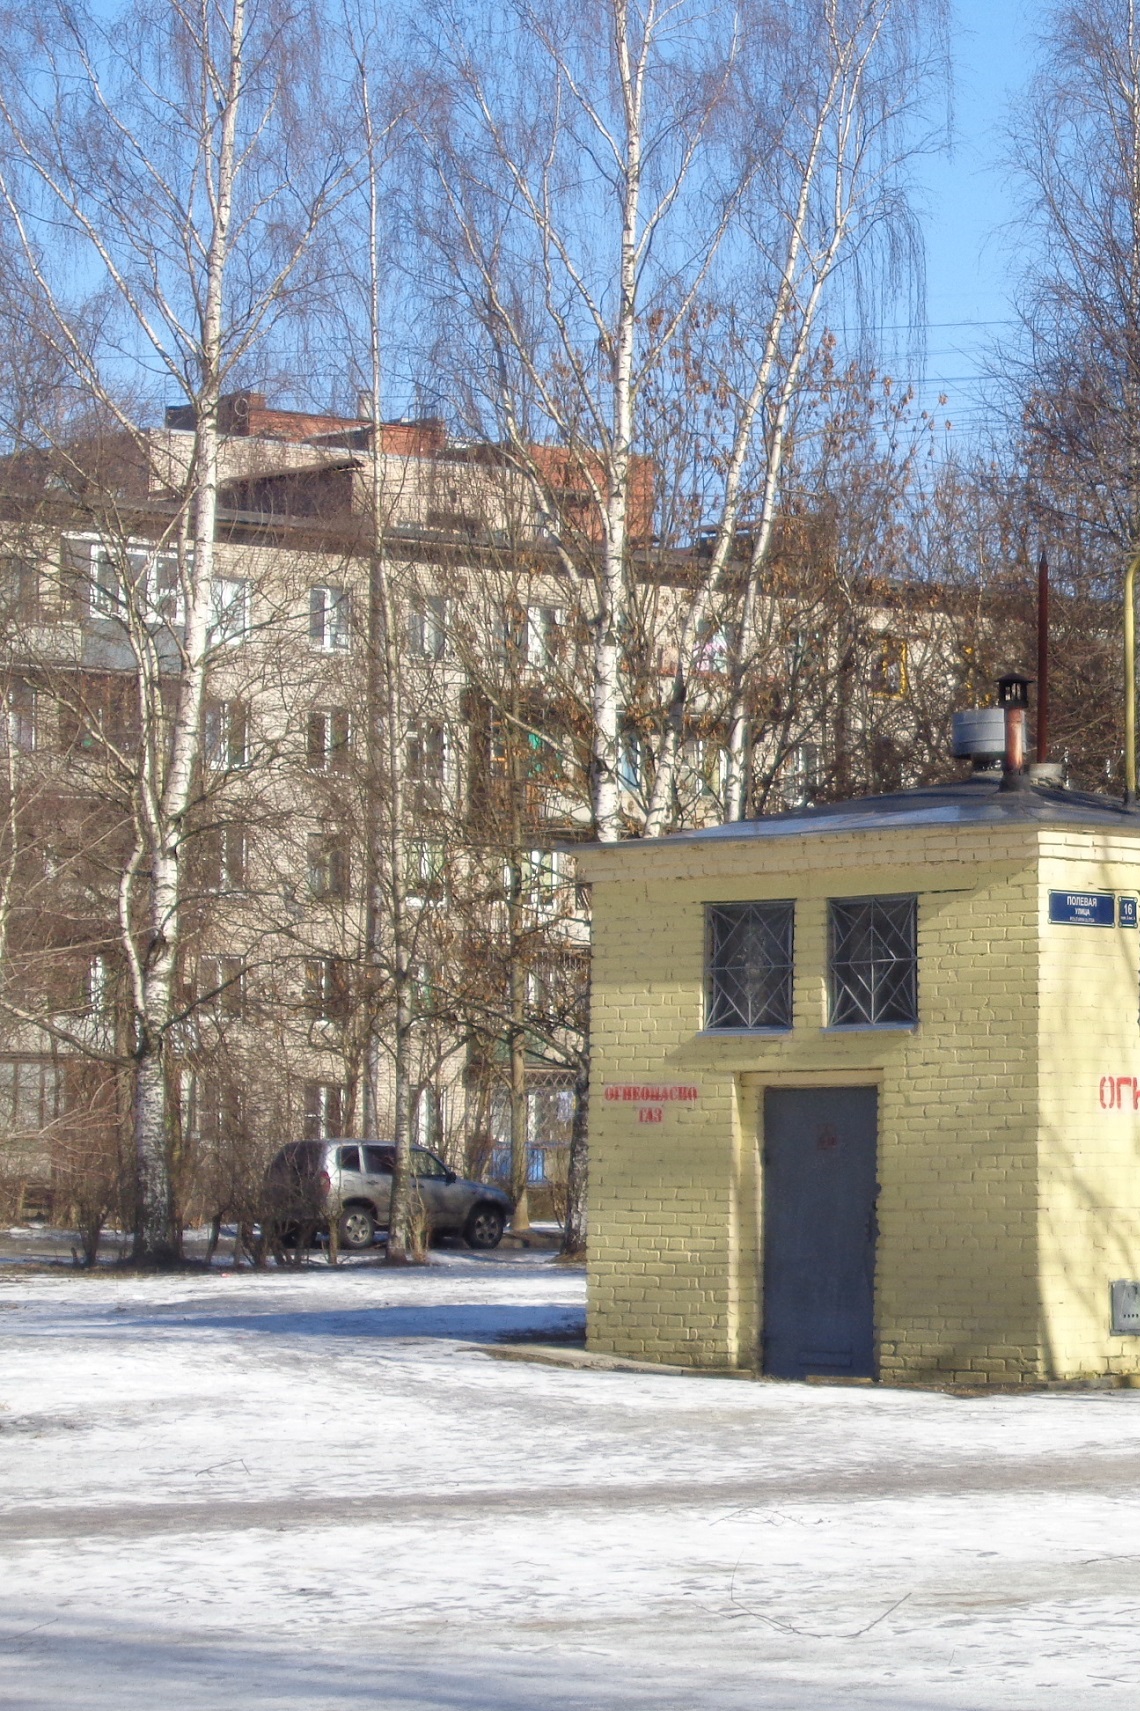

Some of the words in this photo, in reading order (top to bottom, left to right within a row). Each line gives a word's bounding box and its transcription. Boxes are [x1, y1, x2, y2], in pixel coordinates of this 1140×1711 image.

[1066, 896, 1098, 907] ПОЛЕВАЯ
[1074, 908, 1091, 916] УЛИЦА
[1123, 903, 1133, 915] 16
[604, 1086, 698, 1101] ОГНЕОПАСНО
[639, 1107, 663, 1123] ГАЗ
